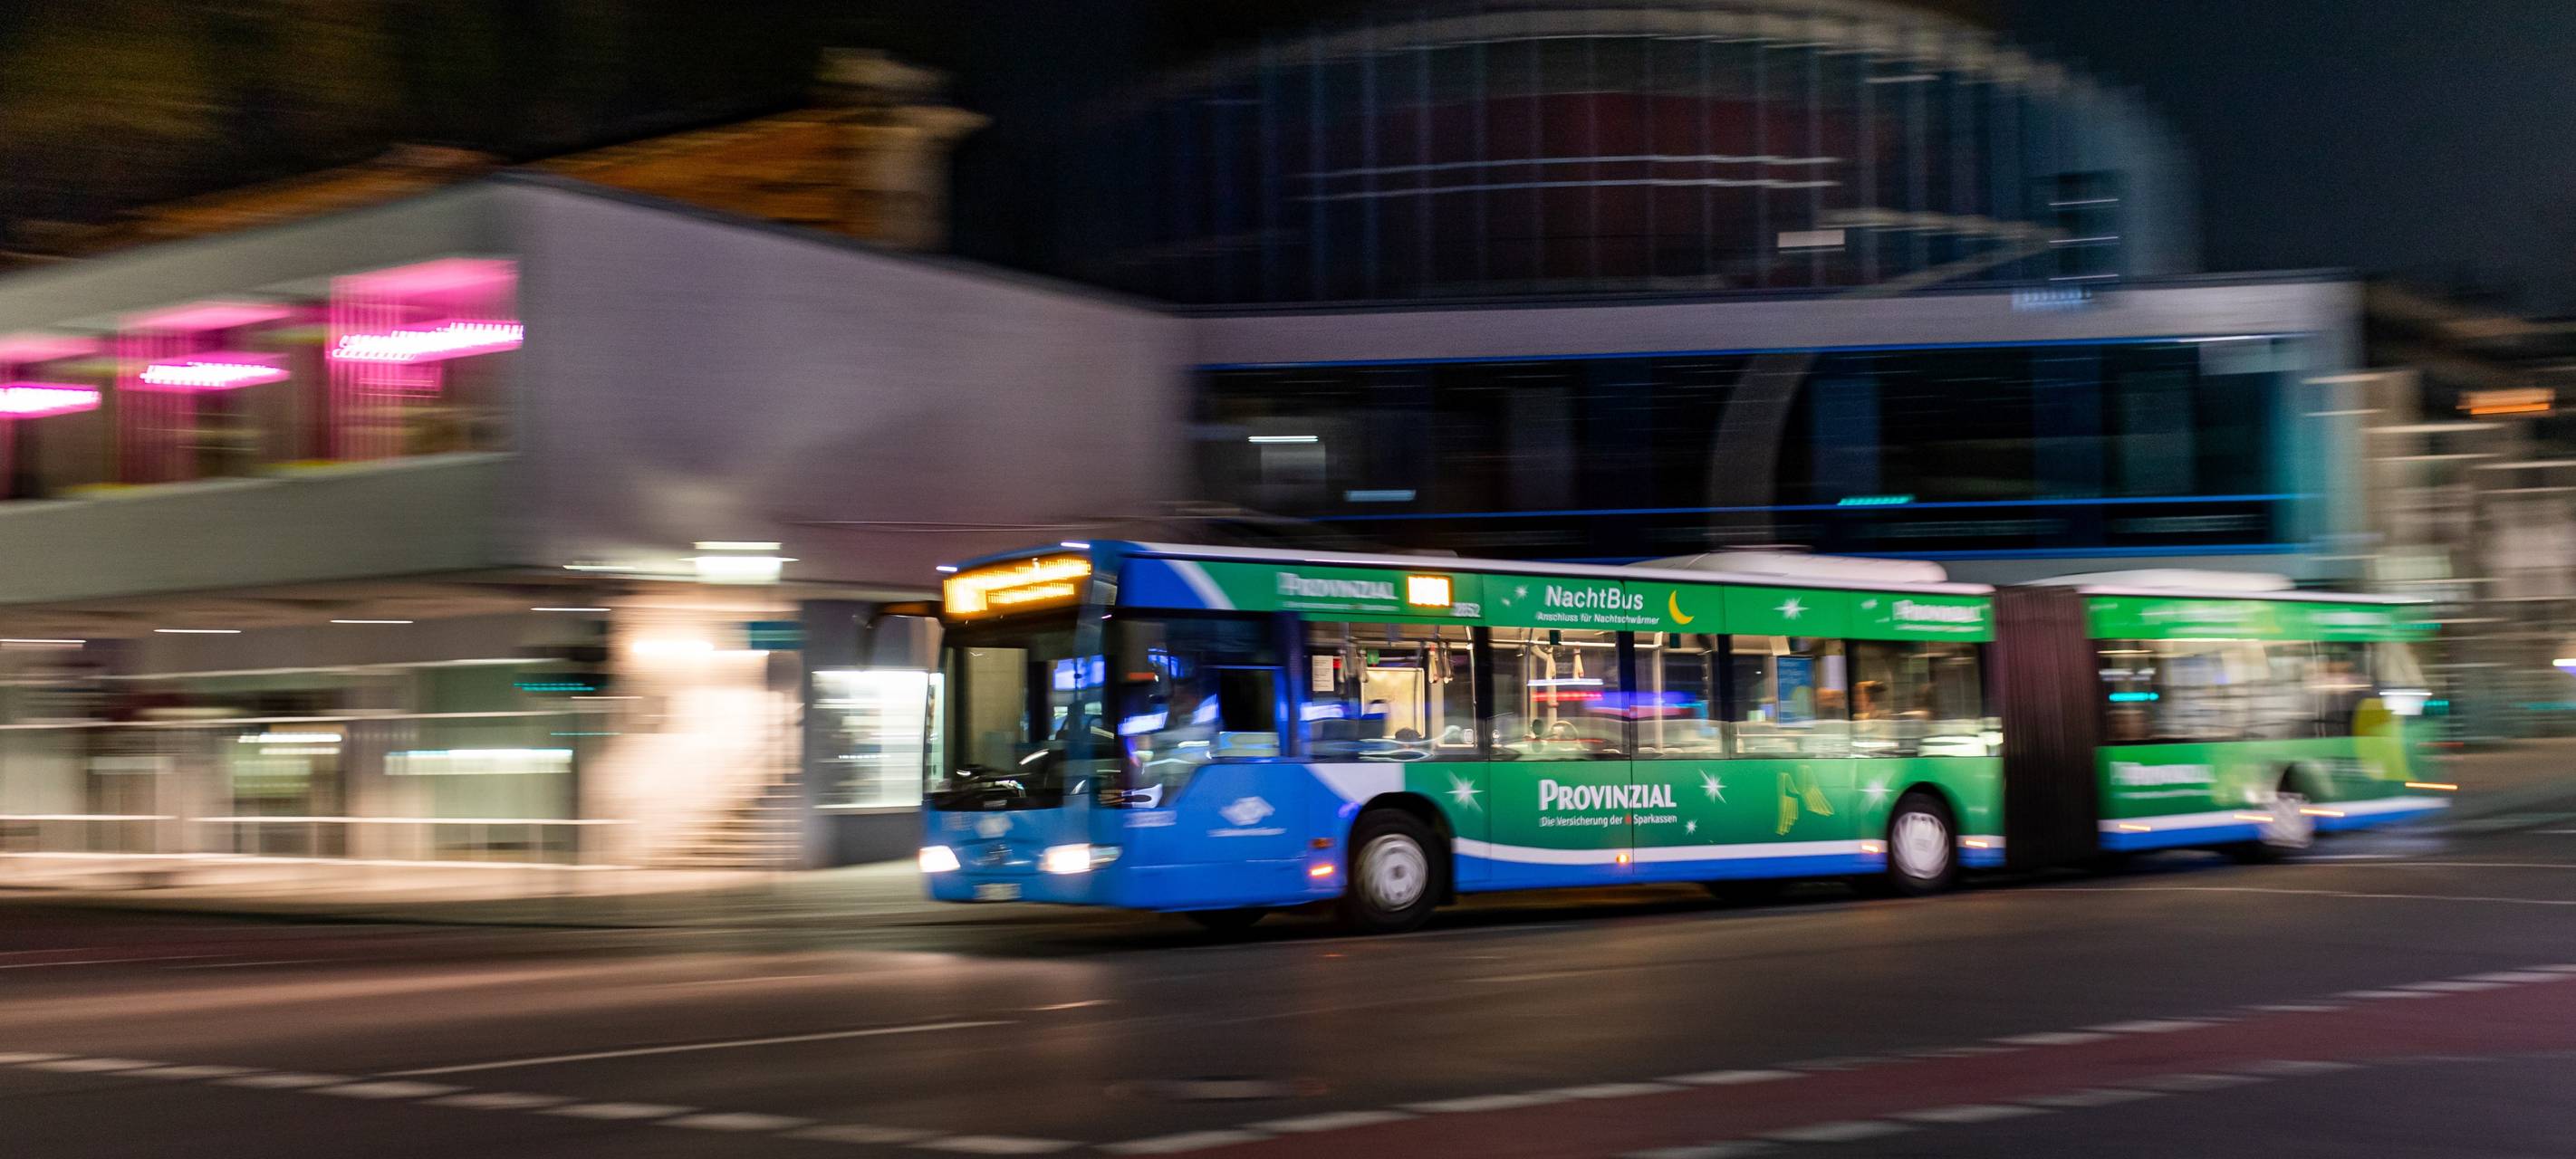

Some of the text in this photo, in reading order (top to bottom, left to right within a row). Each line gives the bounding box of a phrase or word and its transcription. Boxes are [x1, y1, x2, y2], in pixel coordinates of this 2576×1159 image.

[1544, 585, 1644, 610] NachtBus
[1536, 611, 1659, 625] Anschluss für Nachtschwärmer
[1539, 779, 1677, 810] PROVINZIAL
[1540, 814, 1677, 828] Die Versicherung der Sparkassen
